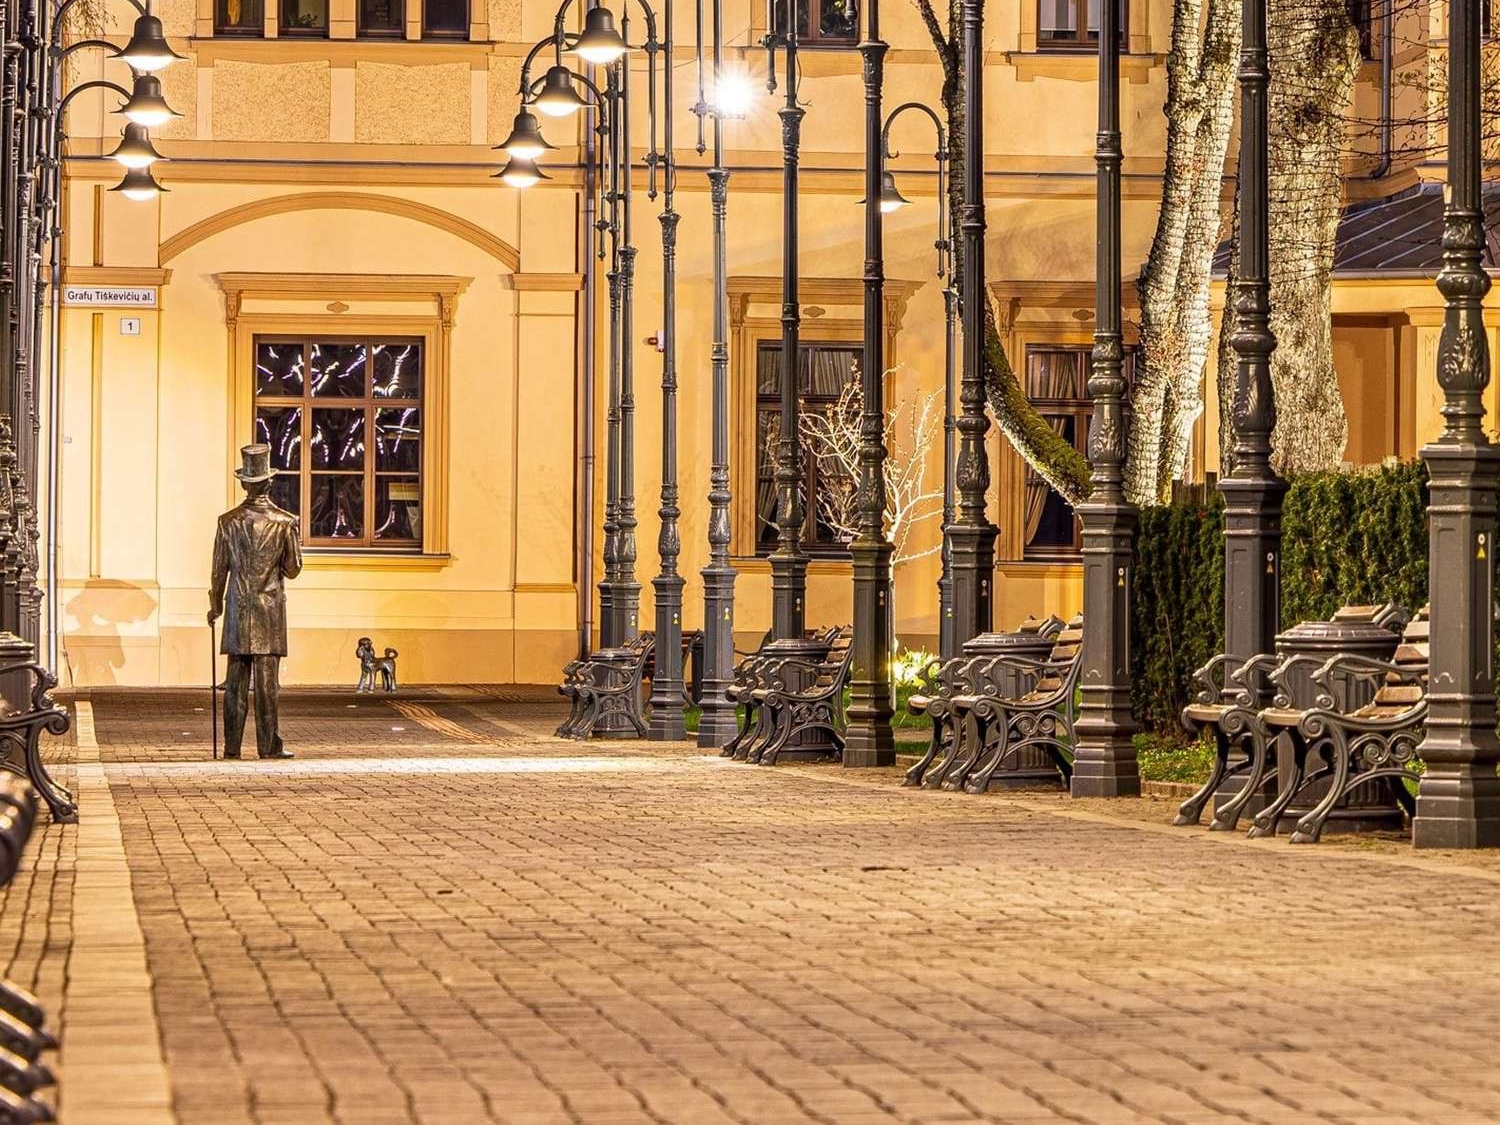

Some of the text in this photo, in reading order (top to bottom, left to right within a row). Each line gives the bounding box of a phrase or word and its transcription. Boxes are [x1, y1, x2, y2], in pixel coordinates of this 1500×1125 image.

[67, 290, 92, 302] Grafų
[142, 291, 153, 301] al.
[127, 322, 133, 331] 1
